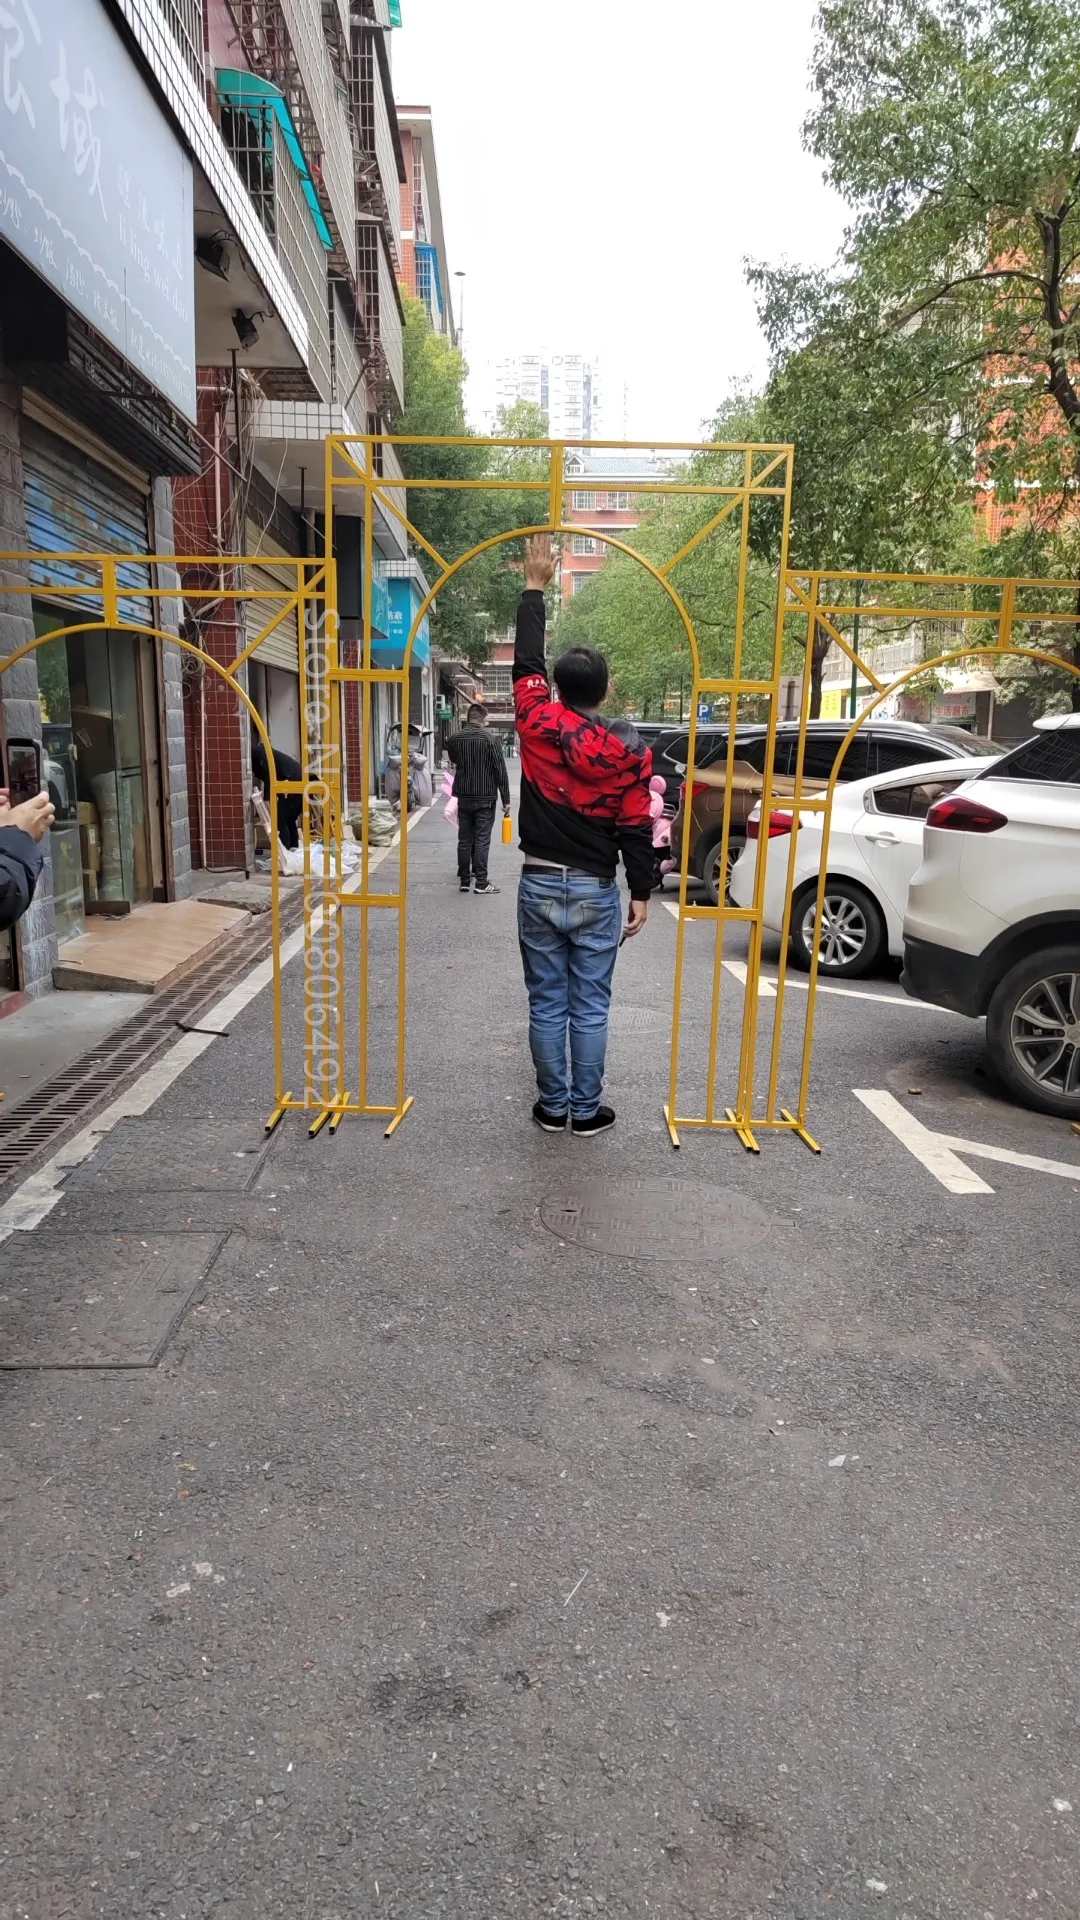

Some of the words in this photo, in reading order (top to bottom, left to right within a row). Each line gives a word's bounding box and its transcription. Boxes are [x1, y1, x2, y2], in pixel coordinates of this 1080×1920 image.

[130, 227, 150, 284] ling
[153, 267, 169, 300] wei
[172, 287, 188, 323] dao
[698, 704, 709, 717] P
